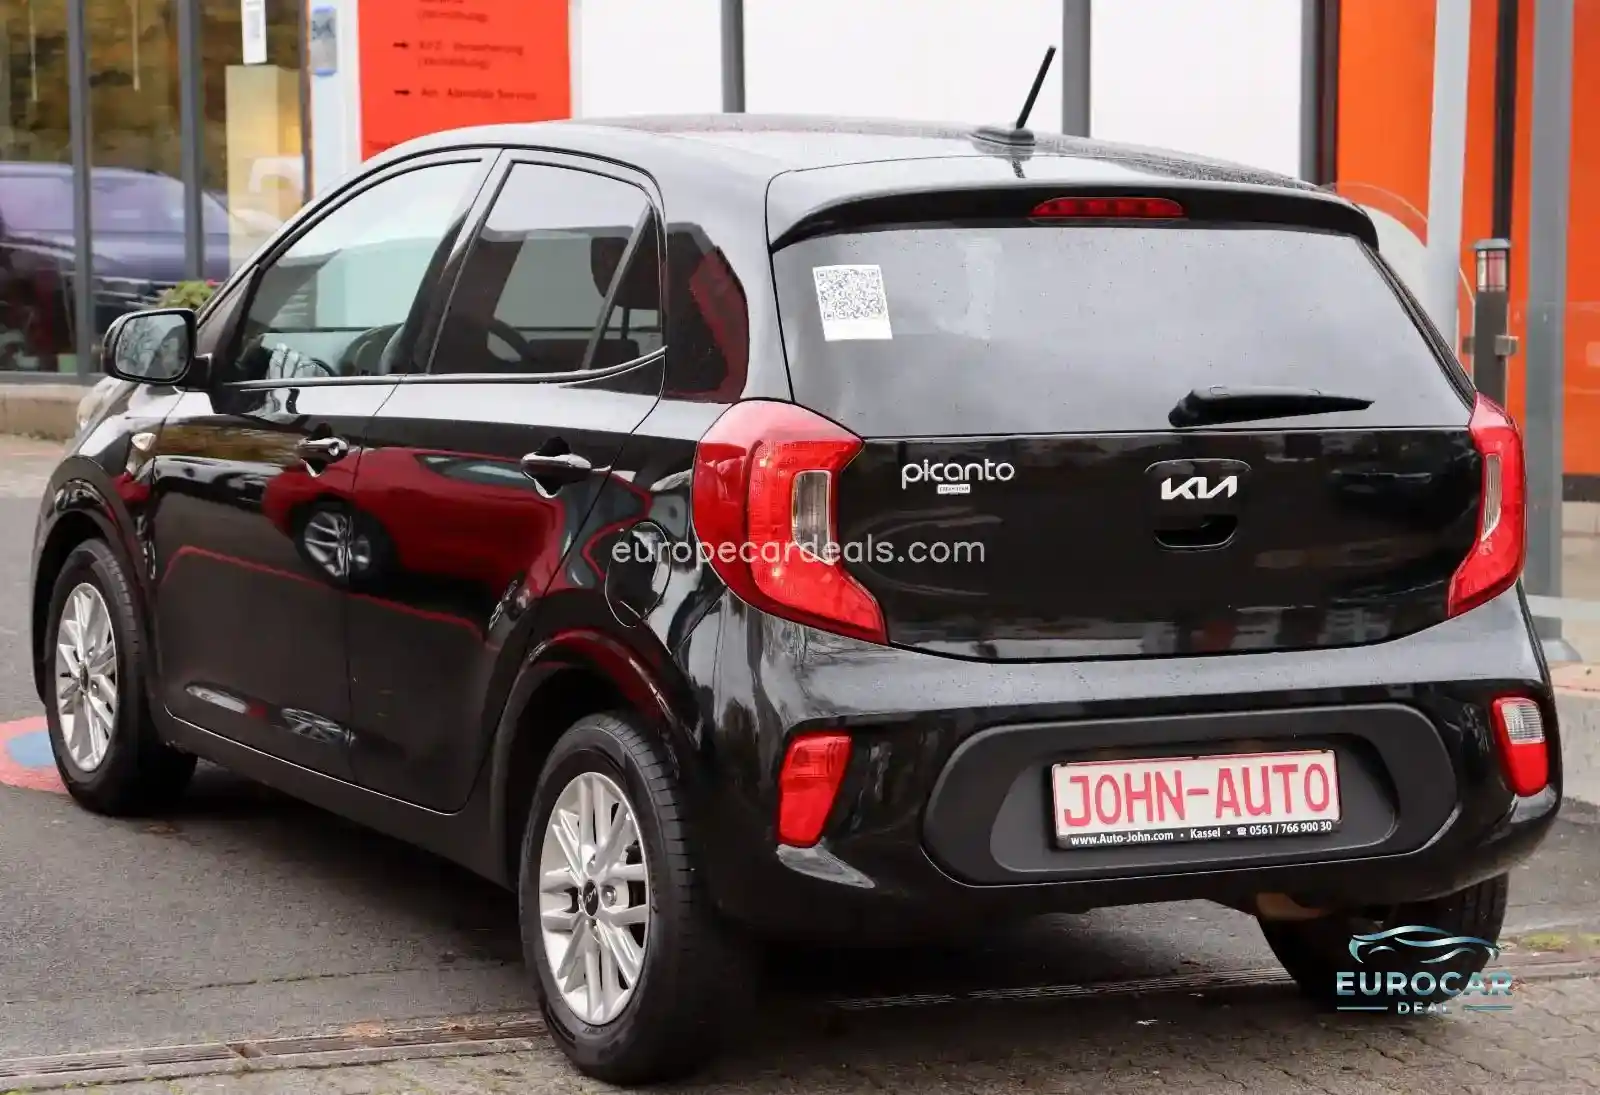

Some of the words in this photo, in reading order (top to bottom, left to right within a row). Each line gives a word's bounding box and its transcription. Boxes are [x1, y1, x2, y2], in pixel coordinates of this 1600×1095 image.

[901, 458, 1015, 490] picanto
[1160, 475, 1238, 500] KIA
[1063, 763, 1330, 827] JOHN-AUTO
[1071, 830, 1174, 846] www.Auto-John.com
[1190, 828, 1221, 839] Kassel
[1250, 824, 1273, 835] 0561
[1281, 823, 1299, 834] 766
[1300, 822, 1318, 833] 900
[1320, 821, 1332, 832] 30
